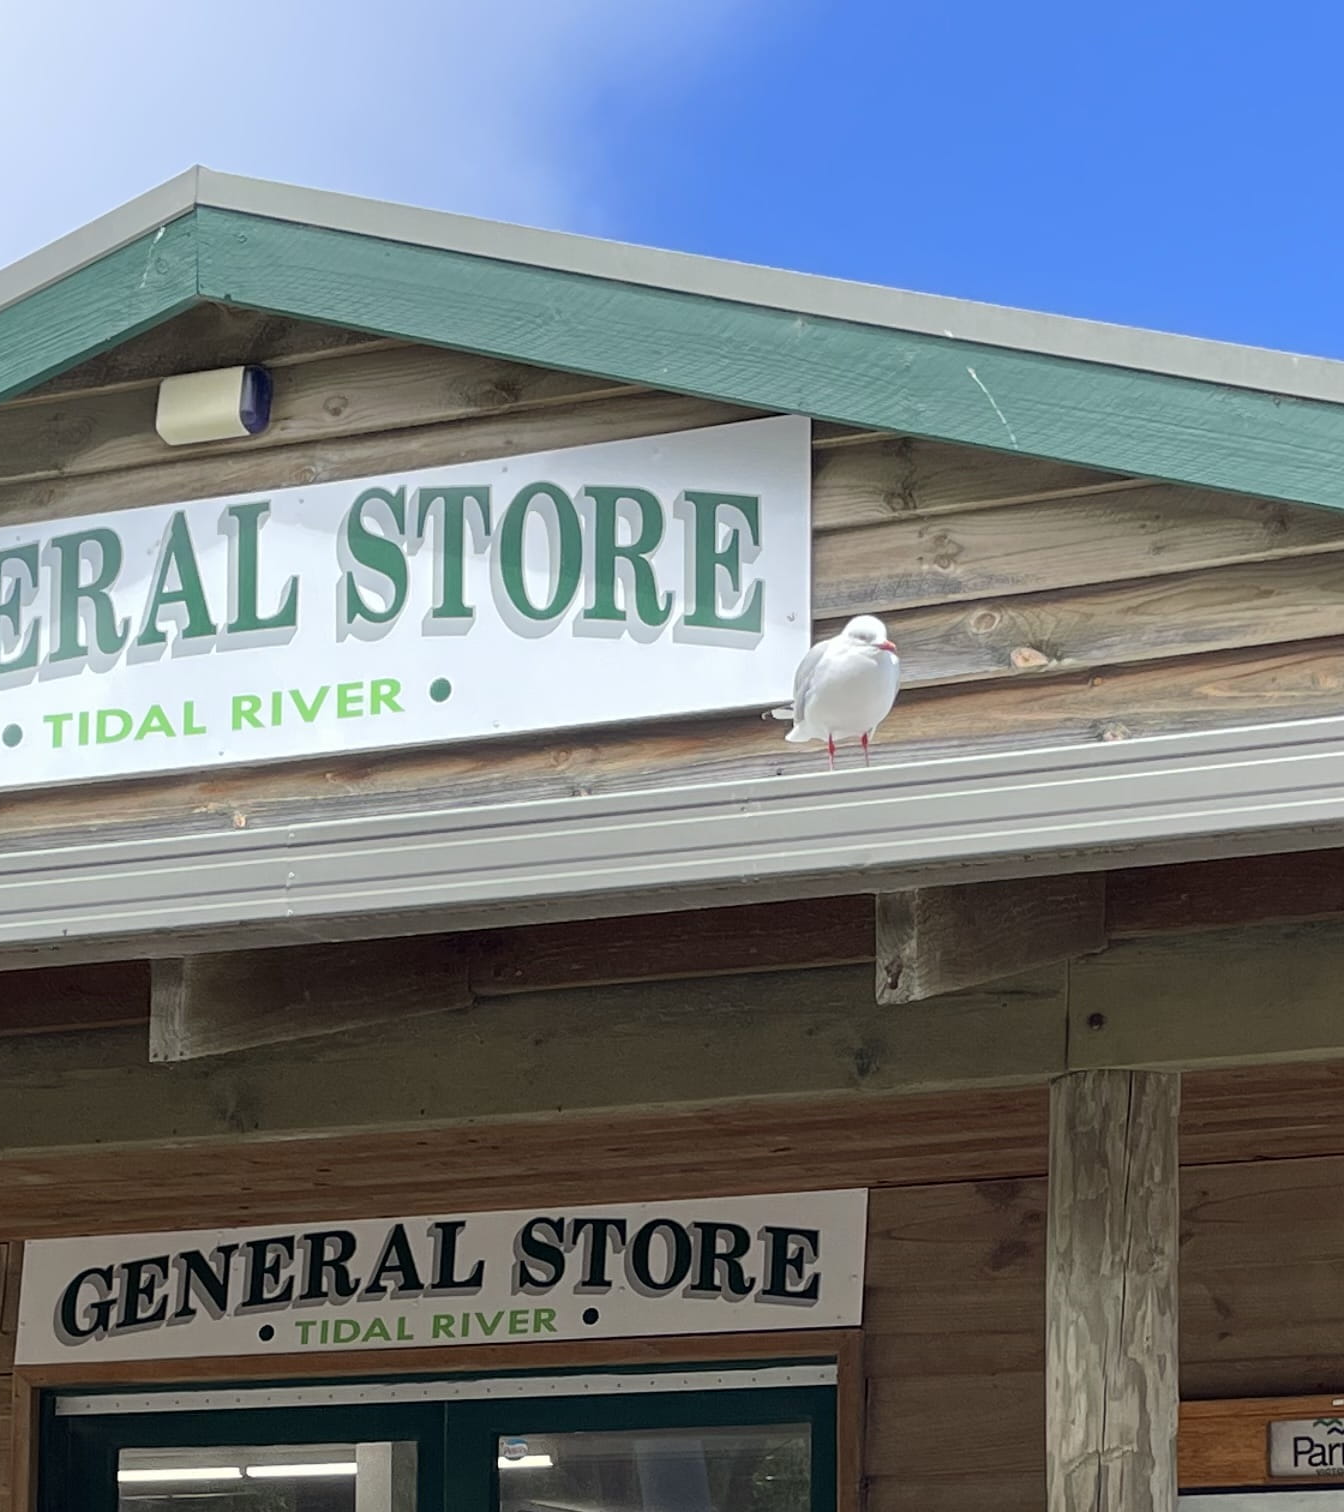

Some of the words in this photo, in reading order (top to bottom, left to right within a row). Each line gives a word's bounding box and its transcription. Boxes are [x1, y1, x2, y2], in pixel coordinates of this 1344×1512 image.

[341, 481, 766, 645] STORE
[43, 700, 207, 750] TIDAL
[230, 678, 405, 733] RIVER
[57, 1219, 485, 1343] GENERAL
[514, 1216, 823, 1305] STORE
[296, 1313, 425, 1345] TIDAL
[432, 1307, 559, 1339] RIVER
